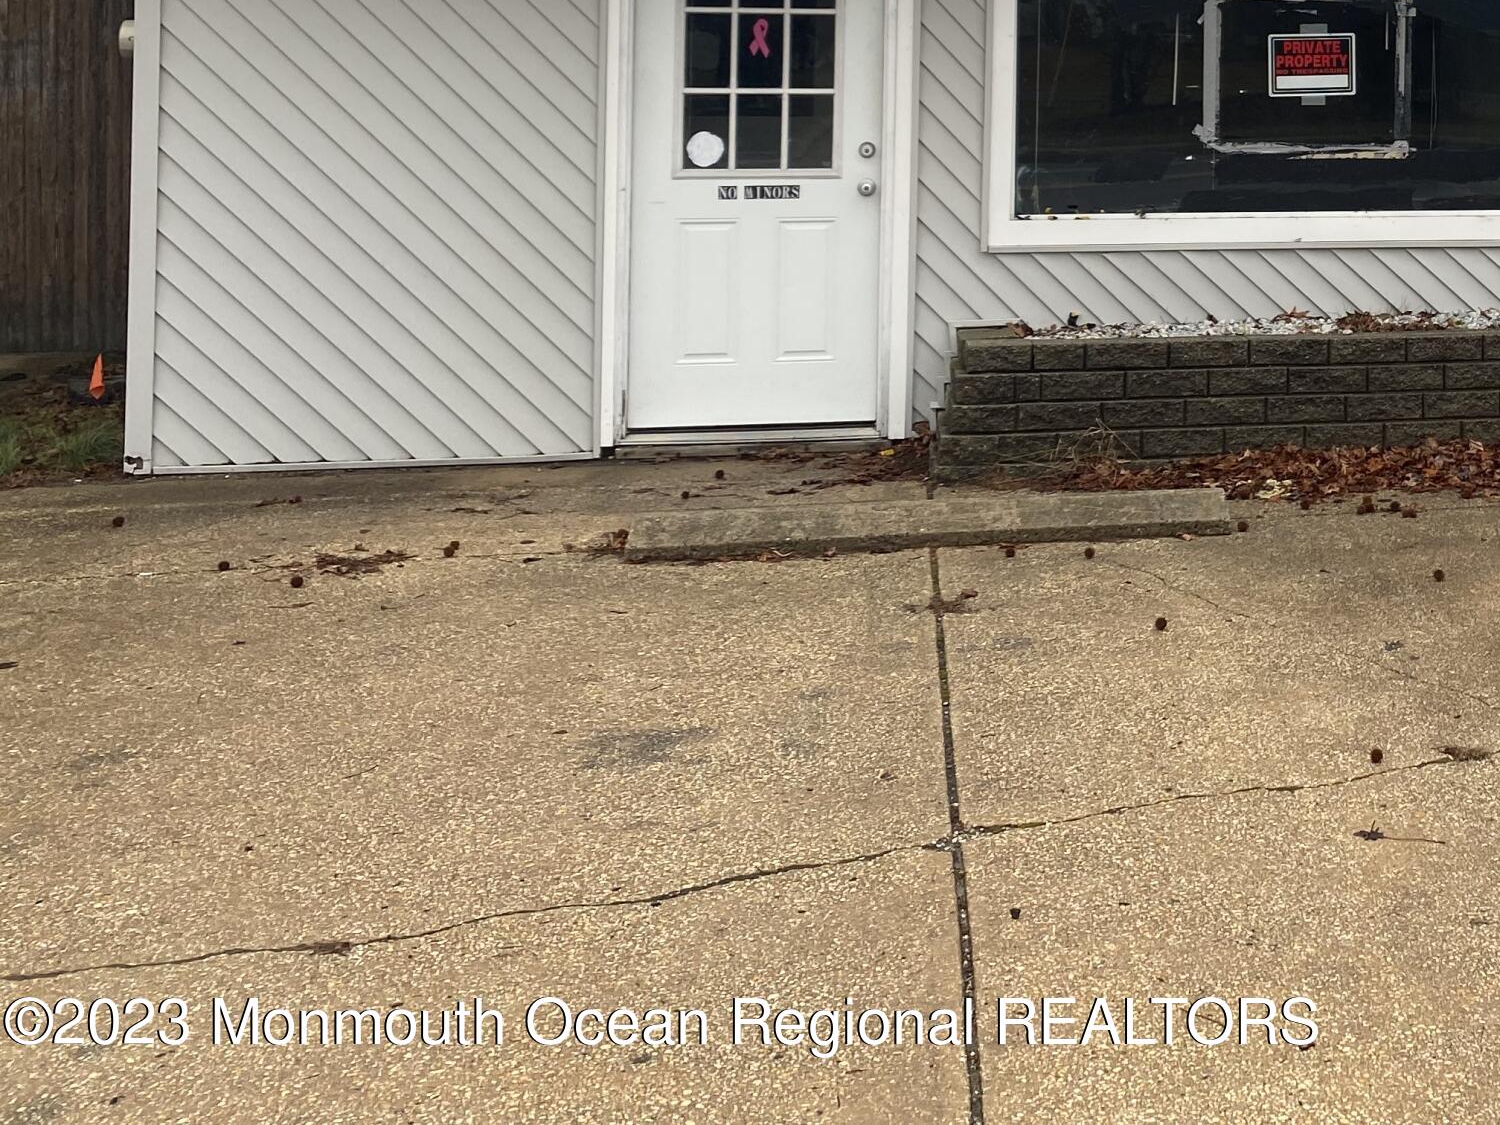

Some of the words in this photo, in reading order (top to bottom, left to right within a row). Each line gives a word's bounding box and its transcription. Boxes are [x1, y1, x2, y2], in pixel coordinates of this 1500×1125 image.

[1283, 40, 1342, 55] PRIVATE
[1276, 53, 1349, 69] PROPERTY
[719, 186, 738, 200] NO
[744, 185, 800, 200] MINORS
